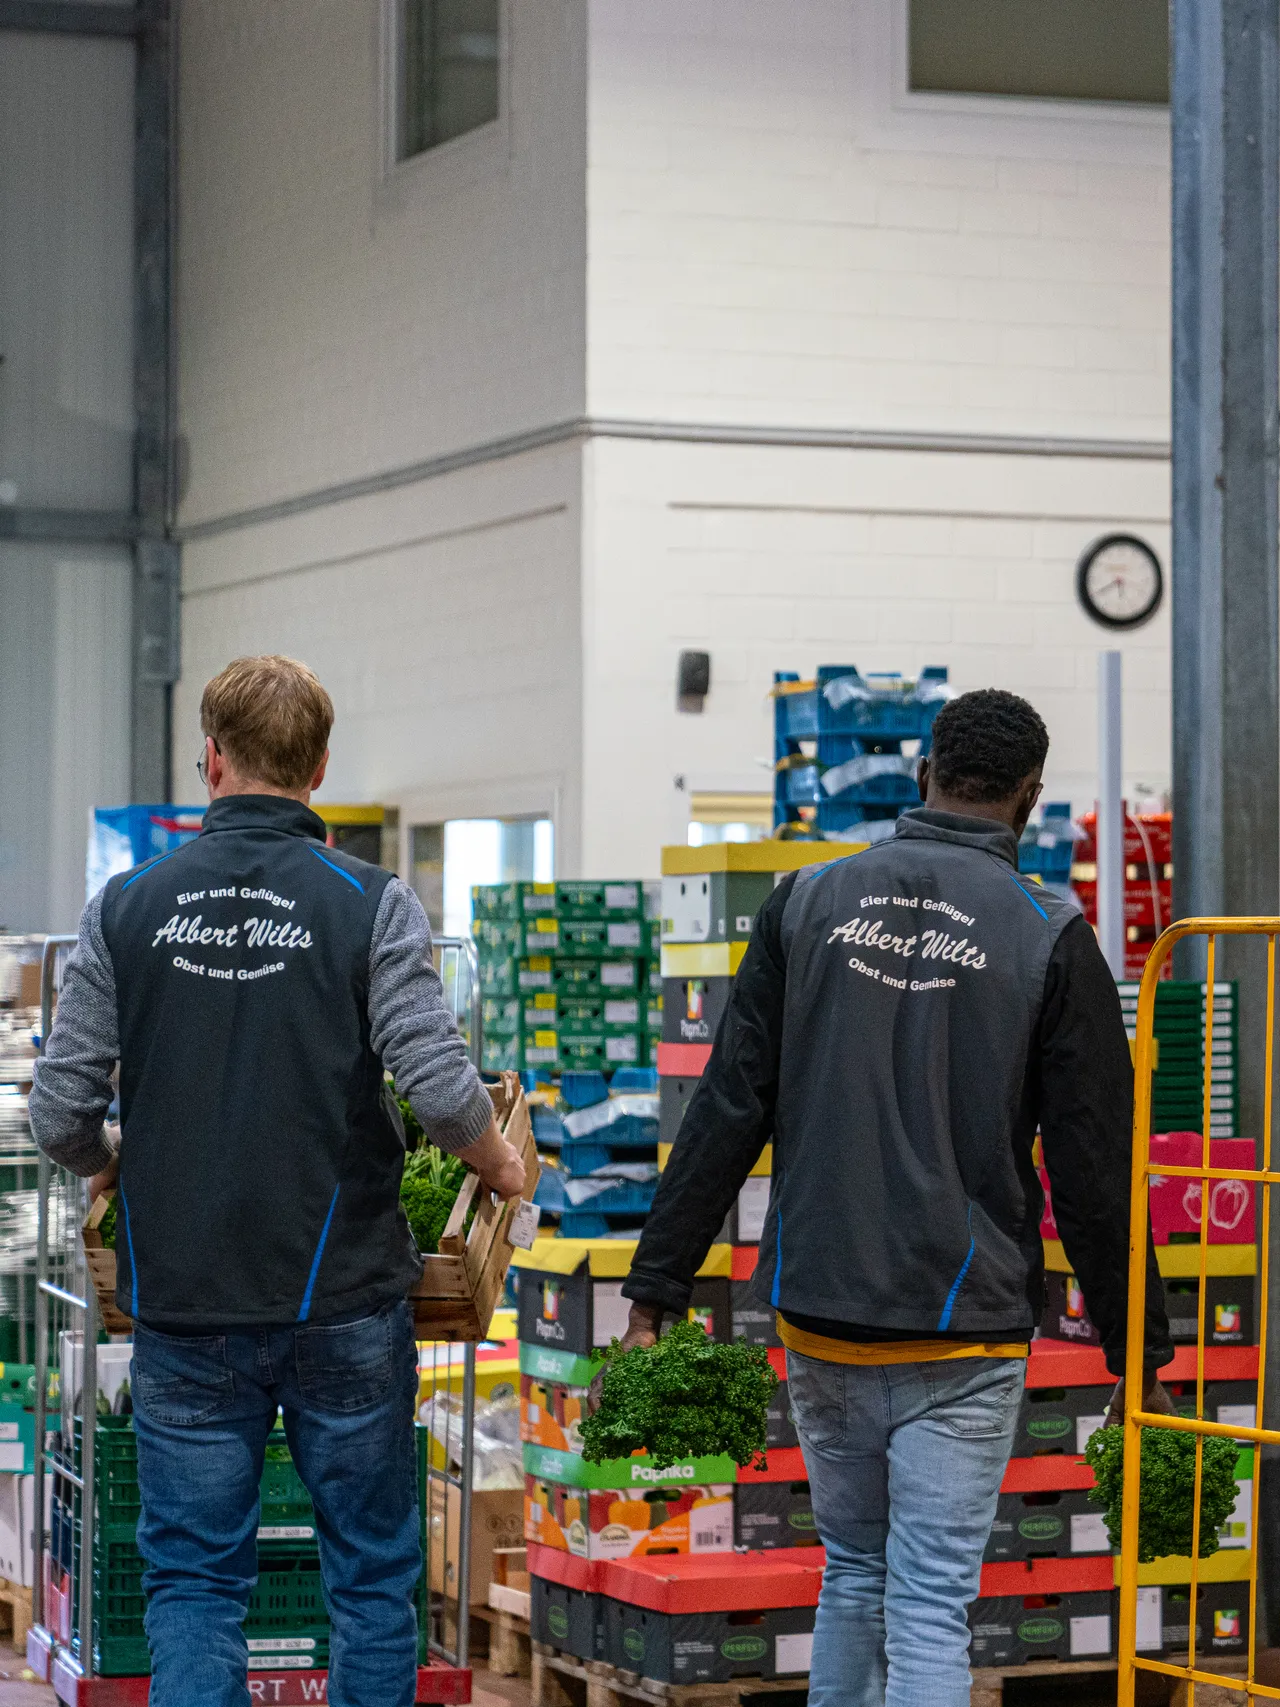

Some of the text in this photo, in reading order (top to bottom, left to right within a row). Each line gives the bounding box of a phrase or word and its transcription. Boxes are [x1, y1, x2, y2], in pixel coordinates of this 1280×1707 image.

[176, 886, 296, 911] Eier und Geflügel
[860, 895, 976, 927] Eier und Geflügel
[151, 914, 314, 948] Albert Wilts
[826, 917, 987, 970] Albert Wilts
[172, 956, 285, 981] Obst und Gemüse
[848, 957, 956, 991] Obst und Gemüse
[631, 1464, 695, 1482] Paprika
